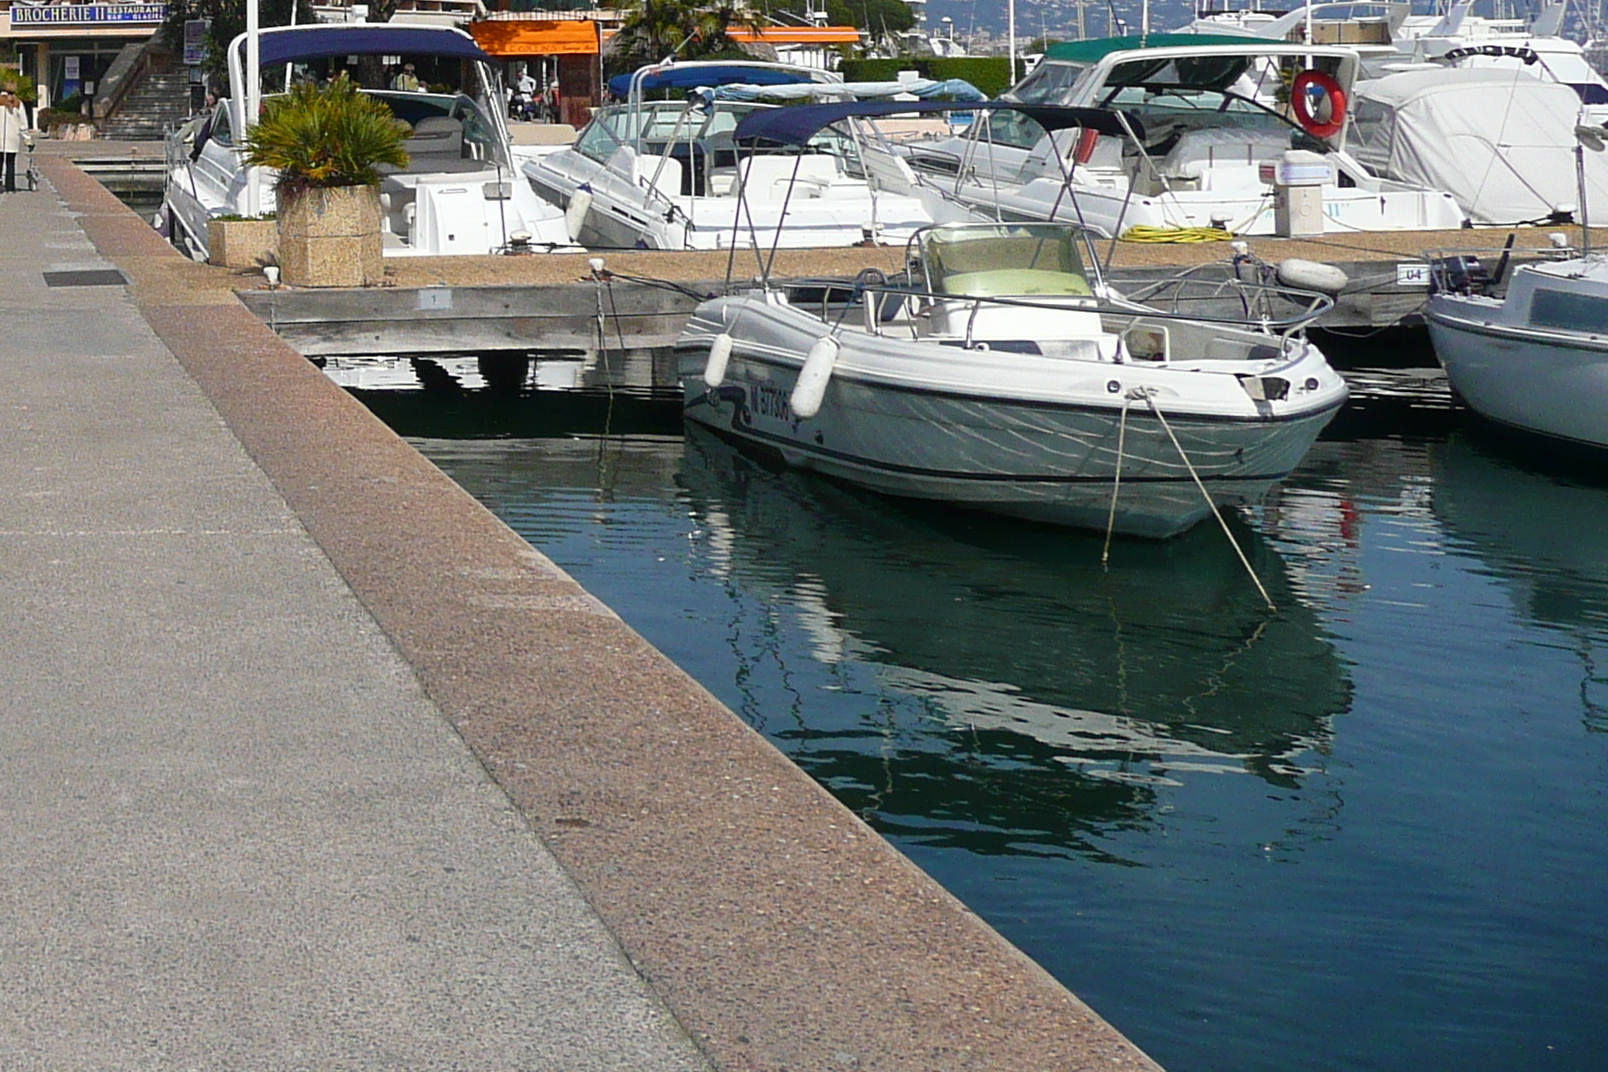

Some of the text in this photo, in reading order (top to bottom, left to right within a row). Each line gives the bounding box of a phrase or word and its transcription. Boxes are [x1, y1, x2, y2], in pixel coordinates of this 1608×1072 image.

[16, 6, 105, 22] BROCHERIE II
[107, 5, 164, 14] RESTAURANT
